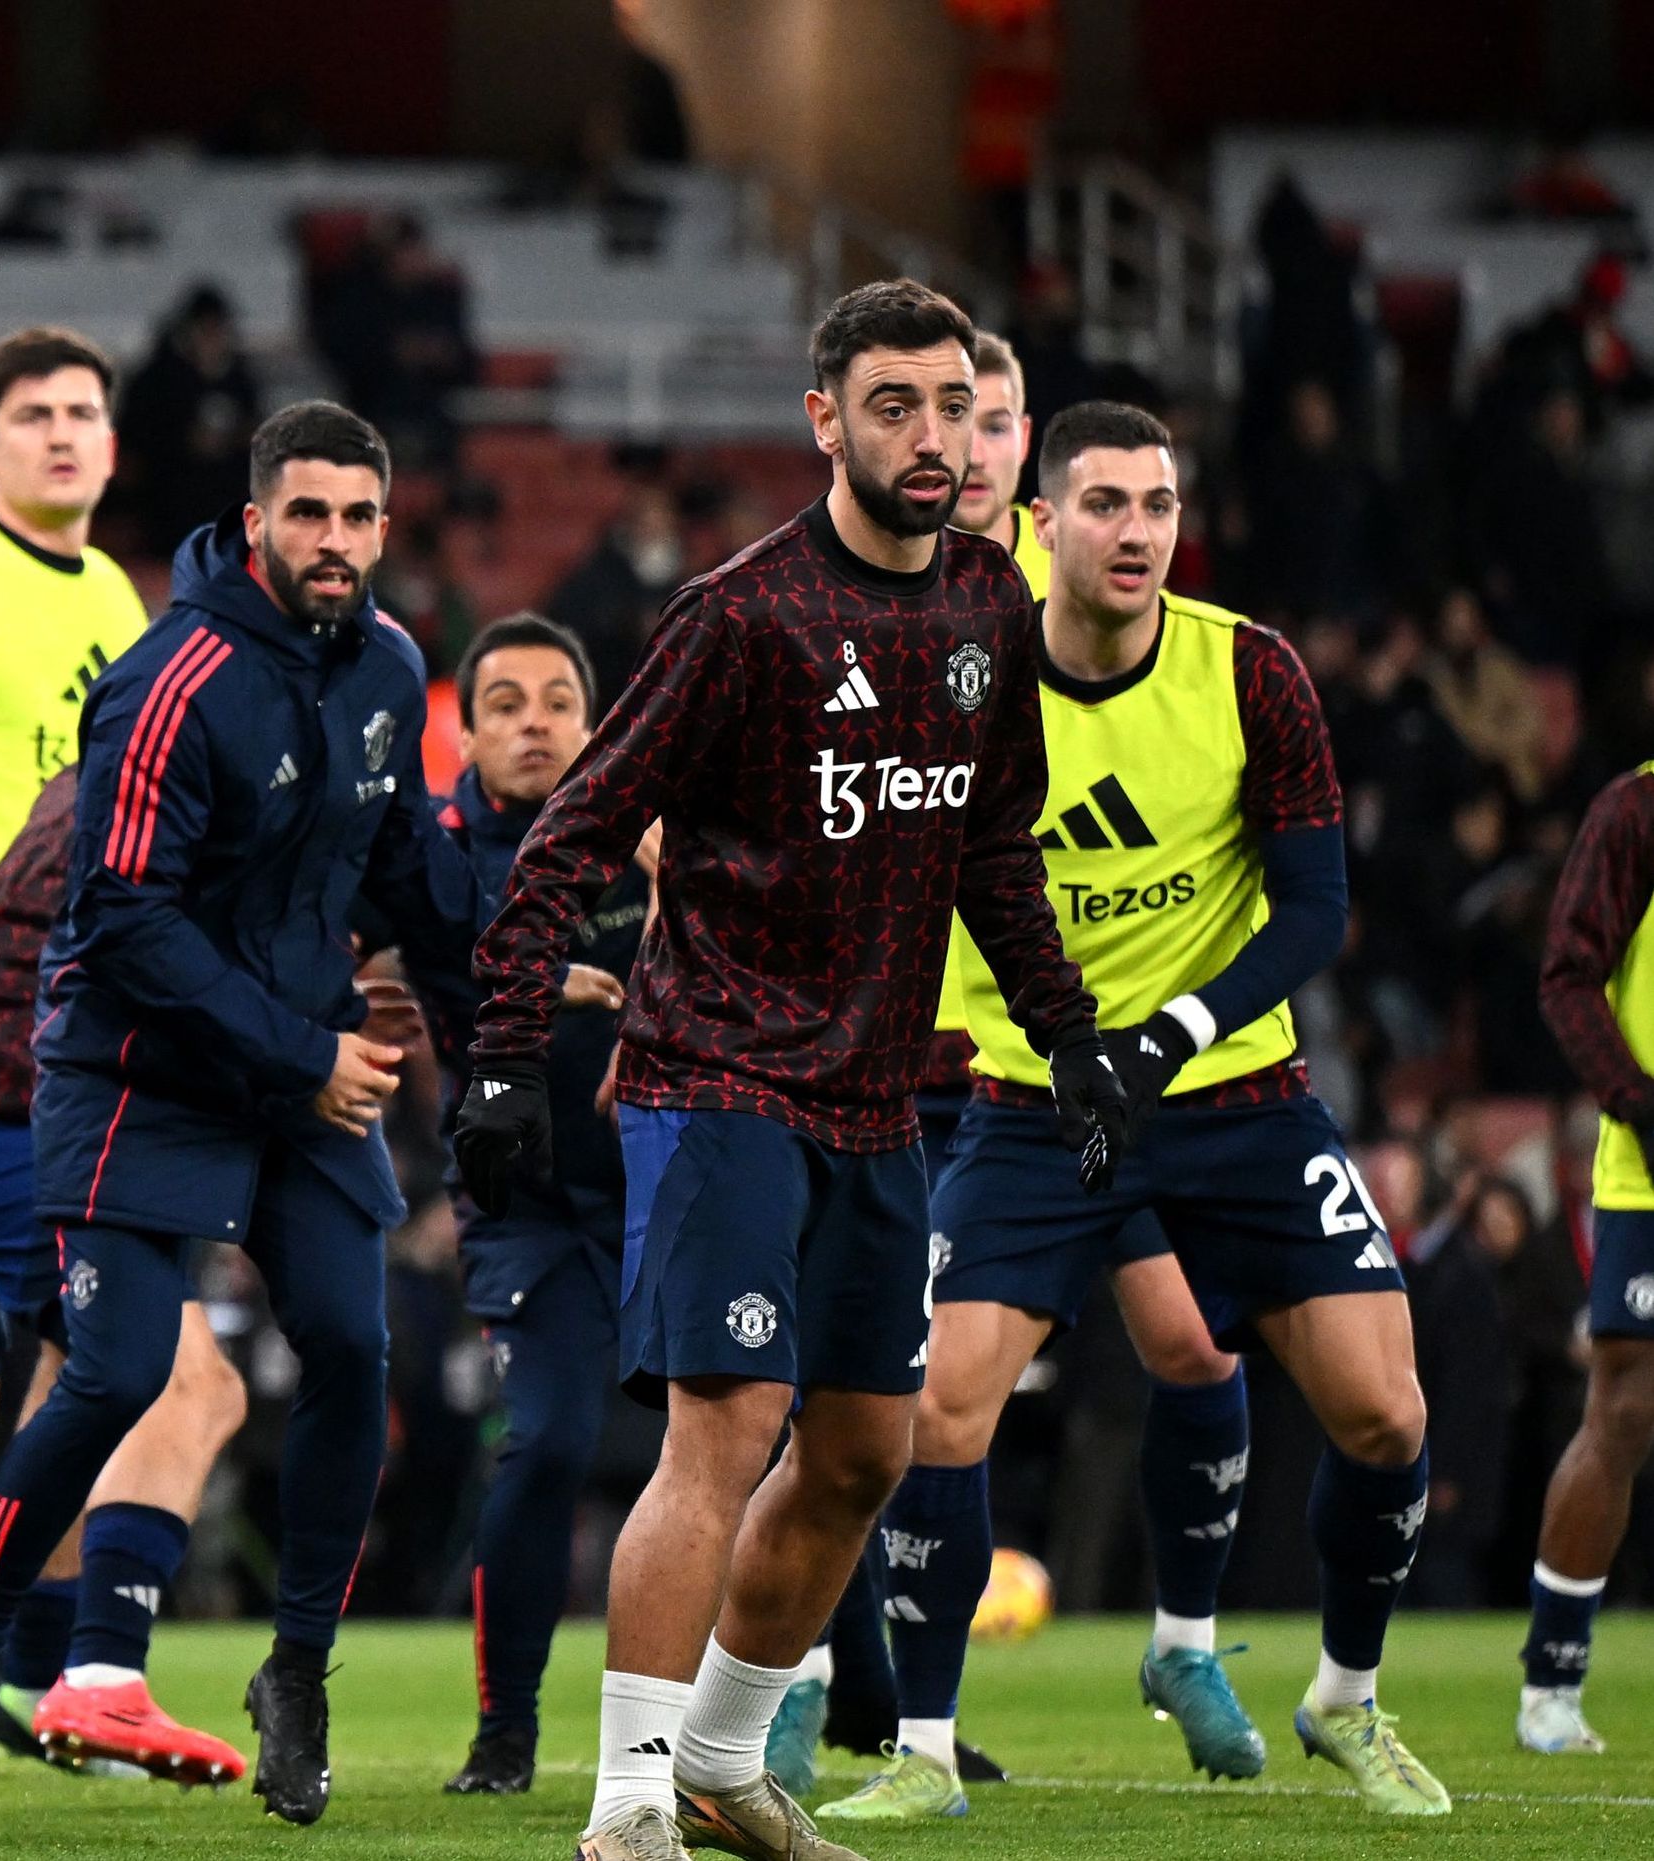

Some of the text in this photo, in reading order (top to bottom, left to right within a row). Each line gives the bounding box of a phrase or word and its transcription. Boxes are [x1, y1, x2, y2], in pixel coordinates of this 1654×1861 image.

[843, 640, 857, 664] 8
[951, 648, 987, 670] MANCHESTER
[958, 695, 982, 707] UNITED
[875, 756, 976, 811] Tezo
[1058, 873, 1196, 925] Tezos
[732, 1297, 773, 1317] MANCHESTER
[737, 1333, 767, 1344] UNITED
